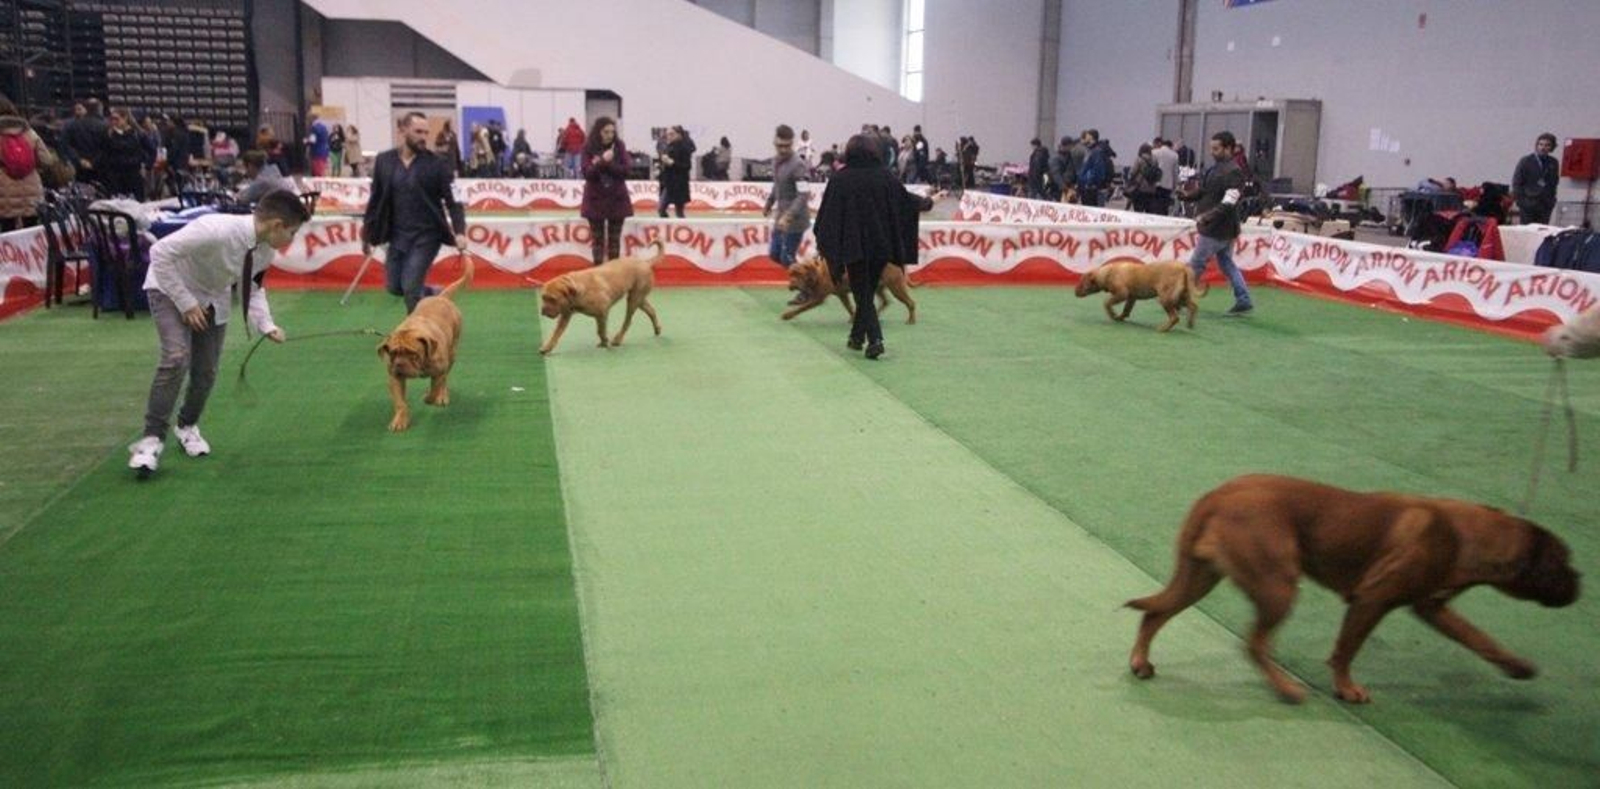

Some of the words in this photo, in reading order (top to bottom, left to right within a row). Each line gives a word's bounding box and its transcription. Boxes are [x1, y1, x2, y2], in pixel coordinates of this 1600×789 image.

[467, 180, 515, 198] ARION
[520, 181, 568, 198] ARION
[303, 222, 362, 260] ARI
[521, 224, 594, 259] ARIO
[623, 225, 715, 257] ARION
[723, 226, 770, 258] ARI
[1001, 230, 1081, 259] ARION
[1088, 228, 1166, 259] ARION
[1296, 241, 1352, 274] ARION
[1355, 251, 1419, 285] ARION
[1421, 260, 1504, 300] ARION
[1503, 274, 1598, 314] ARION
